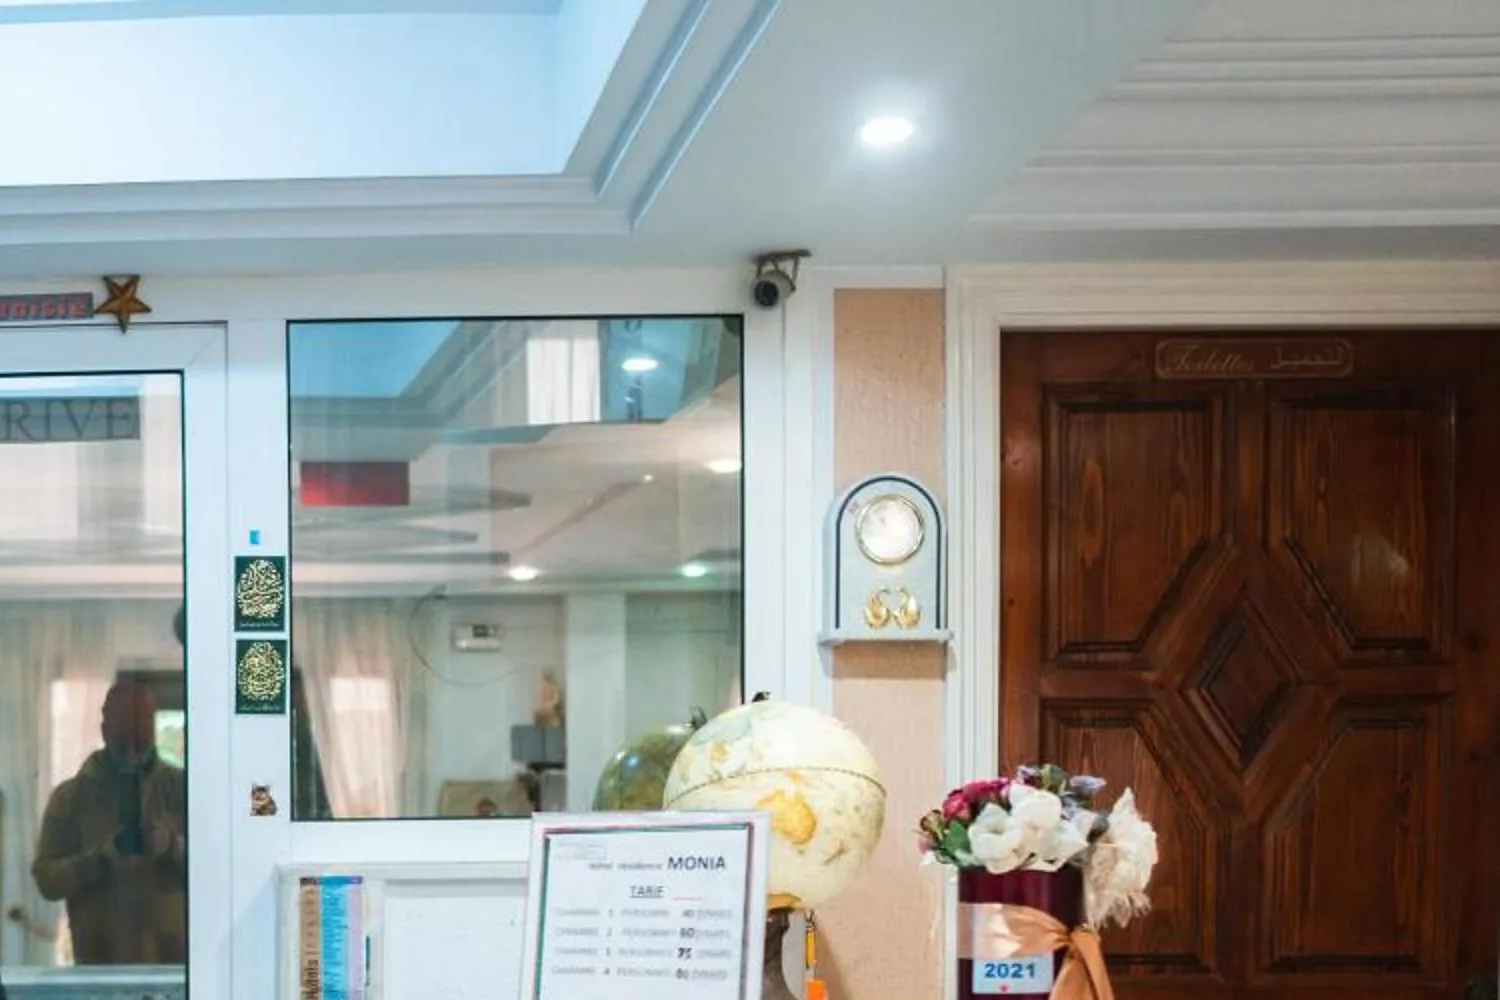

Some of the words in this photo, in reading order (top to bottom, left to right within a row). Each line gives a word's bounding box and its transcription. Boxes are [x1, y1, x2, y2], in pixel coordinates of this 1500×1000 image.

[667, 855, 727, 871] MONIA
[630, 885, 665, 898] TARIF
[984, 963, 1036, 979] 2021
